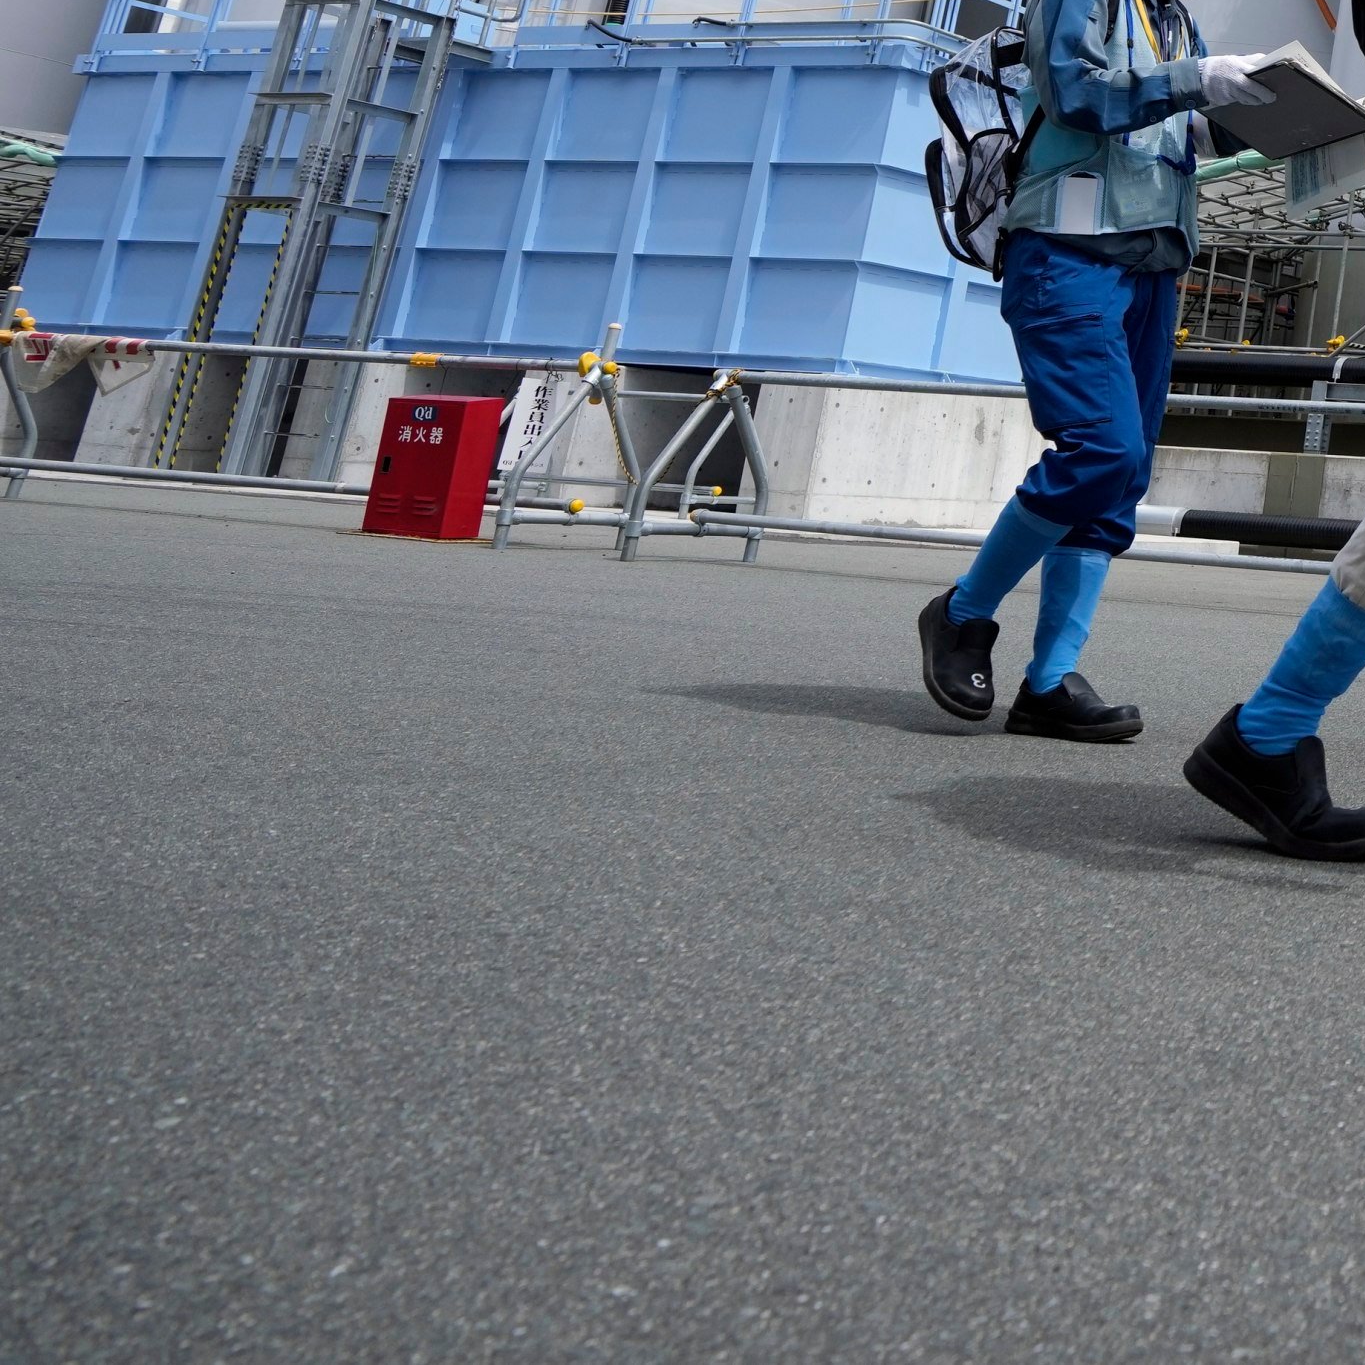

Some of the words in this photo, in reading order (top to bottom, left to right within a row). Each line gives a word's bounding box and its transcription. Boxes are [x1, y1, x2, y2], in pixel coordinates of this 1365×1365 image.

[415, 406, 432, 421] Q'd
[398, 425, 443, 445] 消火器
